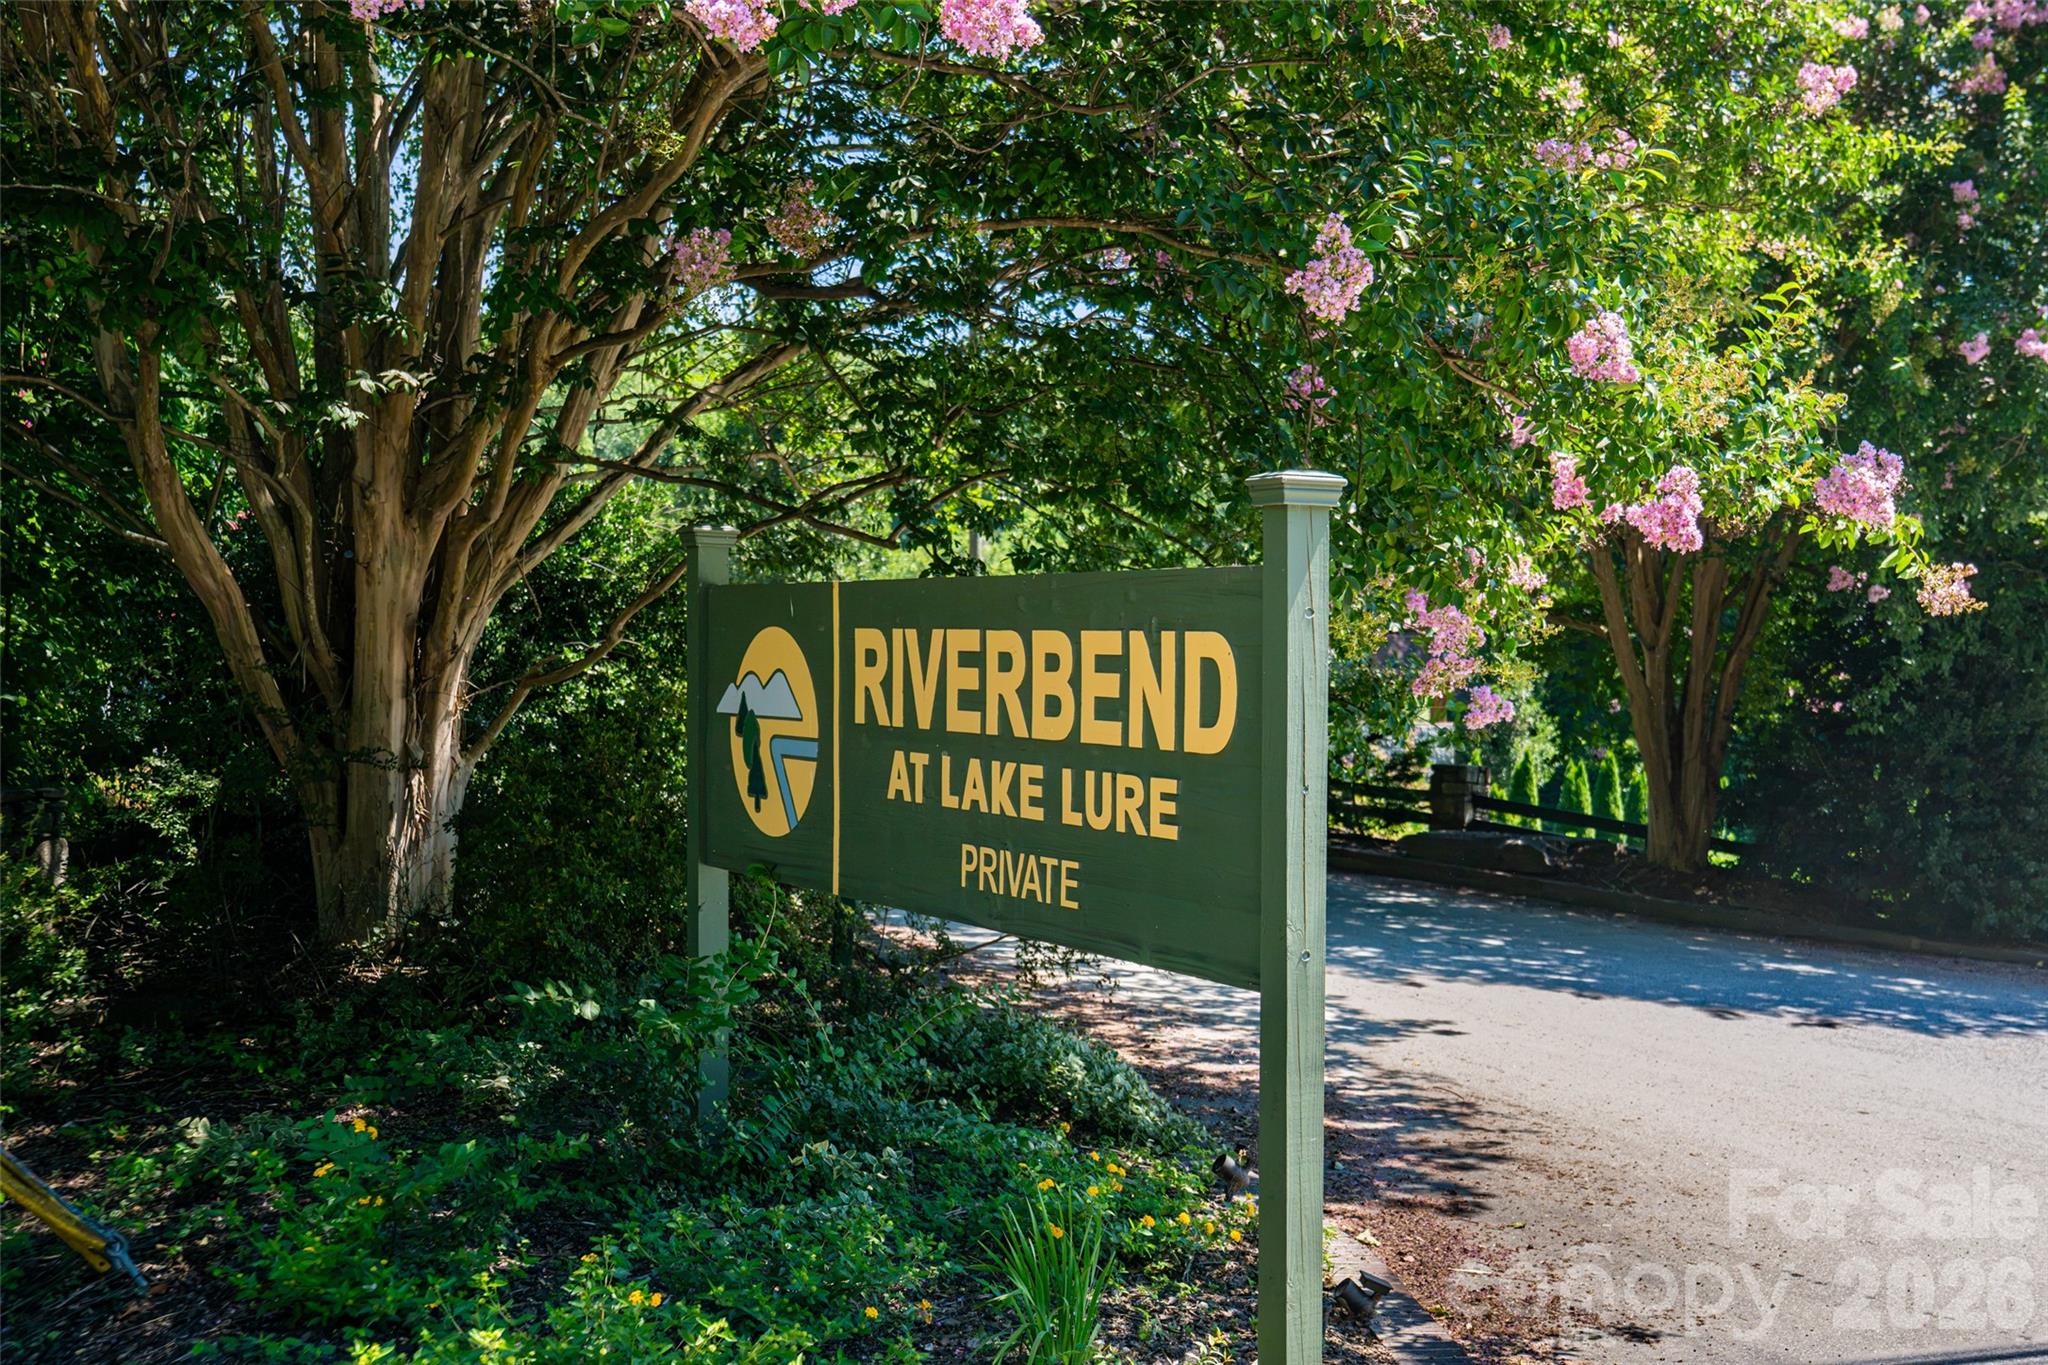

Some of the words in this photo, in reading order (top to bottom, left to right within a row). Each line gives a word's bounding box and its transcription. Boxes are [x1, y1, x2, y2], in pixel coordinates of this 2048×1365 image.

[854, 628, 1238, 755] RIVERBEND
[887, 750, 928, 803] AT
[941, 755, 1044, 821] LAKE
[1061, 767, 1179, 840] LURE
[961, 844, 1080, 909] PRIVATE
